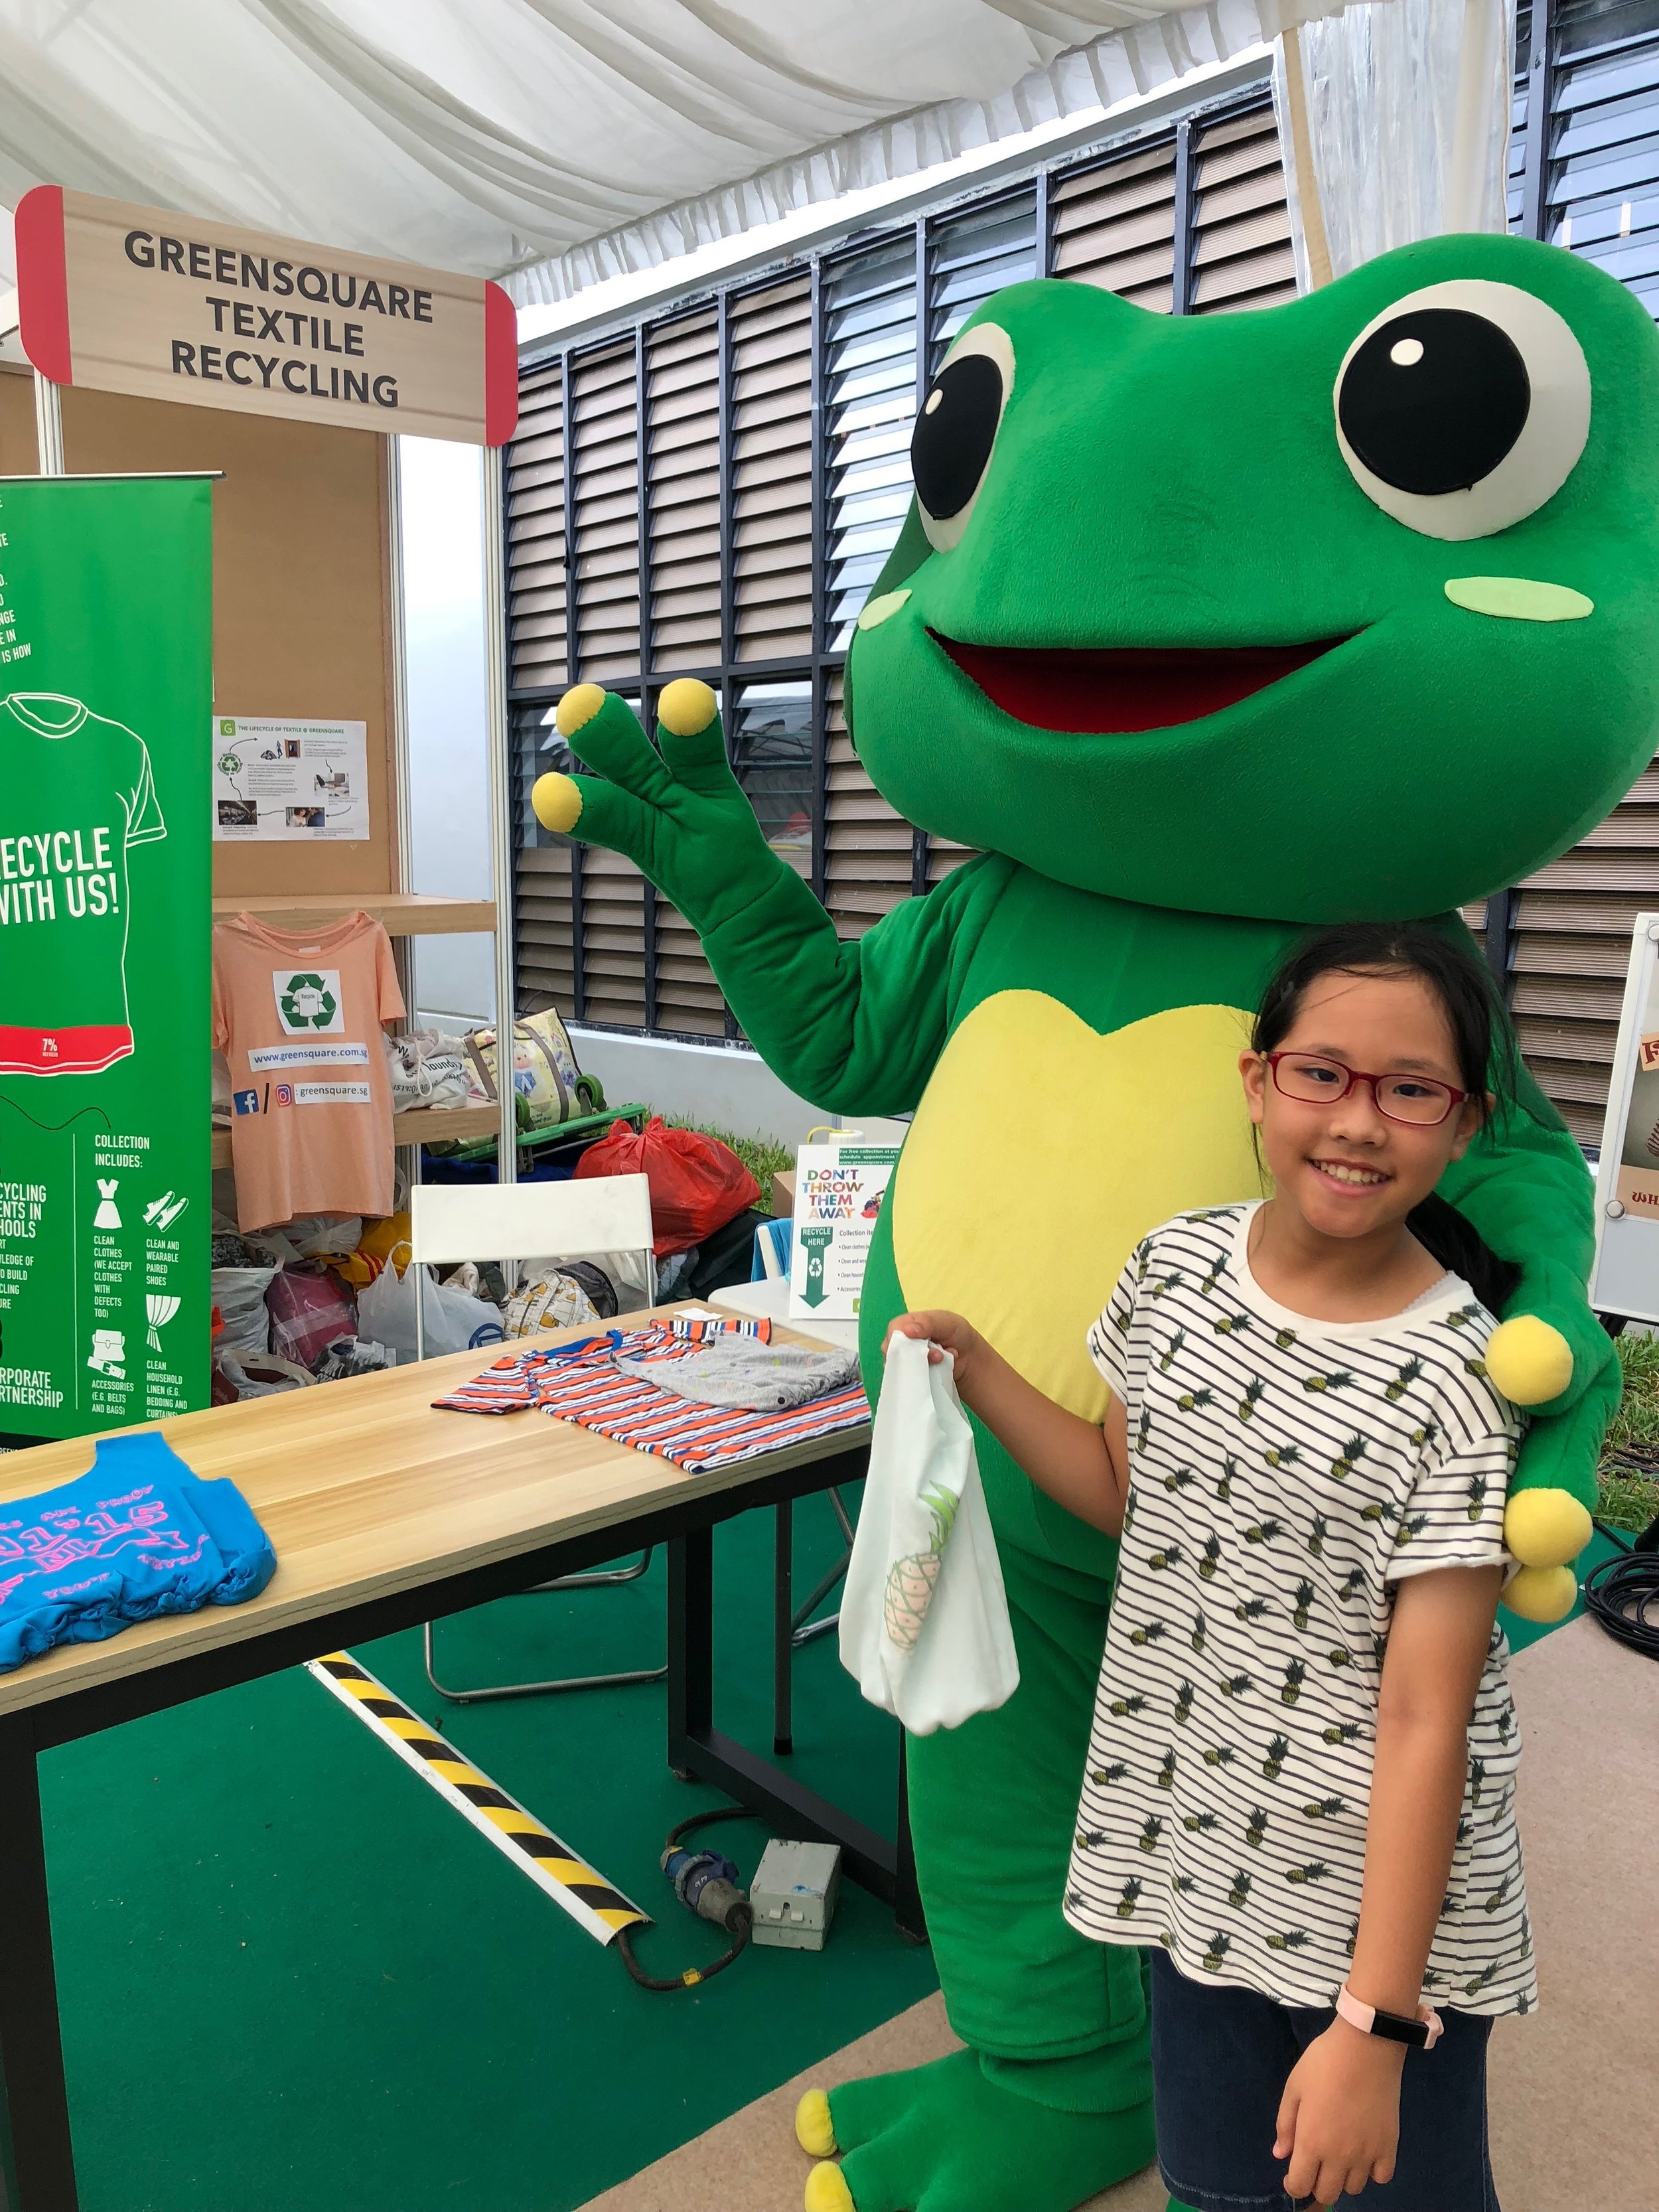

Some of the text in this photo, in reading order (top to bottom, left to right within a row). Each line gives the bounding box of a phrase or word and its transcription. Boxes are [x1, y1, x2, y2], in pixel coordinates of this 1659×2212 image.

[124, 230, 433, 323] GREENSQUARE
[206, 297, 364, 357] TEXTILE
[172, 340, 399, 408] RECYCLING
[1, 642, 31, 664] IS HOW
[66, 872, 119, 918] US!
[42, 1038, 58, 1052] 7%
[254, 1049, 368, 1063] www.greensquare.com.sg
[300, 1087, 368, 1098] greensquare.sg
[95, 1134, 149, 1149] COLLECTION
[95, 1153, 143, 1168] INCLUDES:
[807, 1169, 859, 1181] DON'T
[802, 1181, 864, 1193] THROW
[809, 1195, 853, 1206] THEM
[1632, 1191, 1659, 1206] WH
[30, 1203, 42, 1220] IN
[808, 1207, 855, 1219] AWAY
[94, 1236, 115, 1246] CLEAN
[146, 1238, 179, 1250] CLEAN AND
[94, 1248, 122, 1258] CLOTHES
[146, 1251, 179, 1263] WEARABLE
[0, 1254, 35, 1266] LEDGE OF
[94, 1260, 132, 1271] (WE ACCEPT
[7, 1269, 27, 1281] BUILD
[146, 1264, 168, 1274] PAIRED
[94, 1272, 122, 1283] CLOTHES
[146, 1276, 167, 1286] SHOES
[94, 1284, 110, 1293] WITH
[94, 1296, 122, 1307] DEFECTS
[94, 1308, 109, 1319] TOO)
[146, 1360, 167, 1370] CLEAN
[147, 1372, 182, 1384] HOUSEHOLD
[92, 1380, 134, 1392] ACCESSORIES
[147, 1384, 180, 1396] LINEN (E.G.
[92, 1391, 126, 1403] (E.G. BELTS
[147, 1396, 187, 1410] BEDDING AND
[92, 1404, 125, 1416] AND BAGS)
